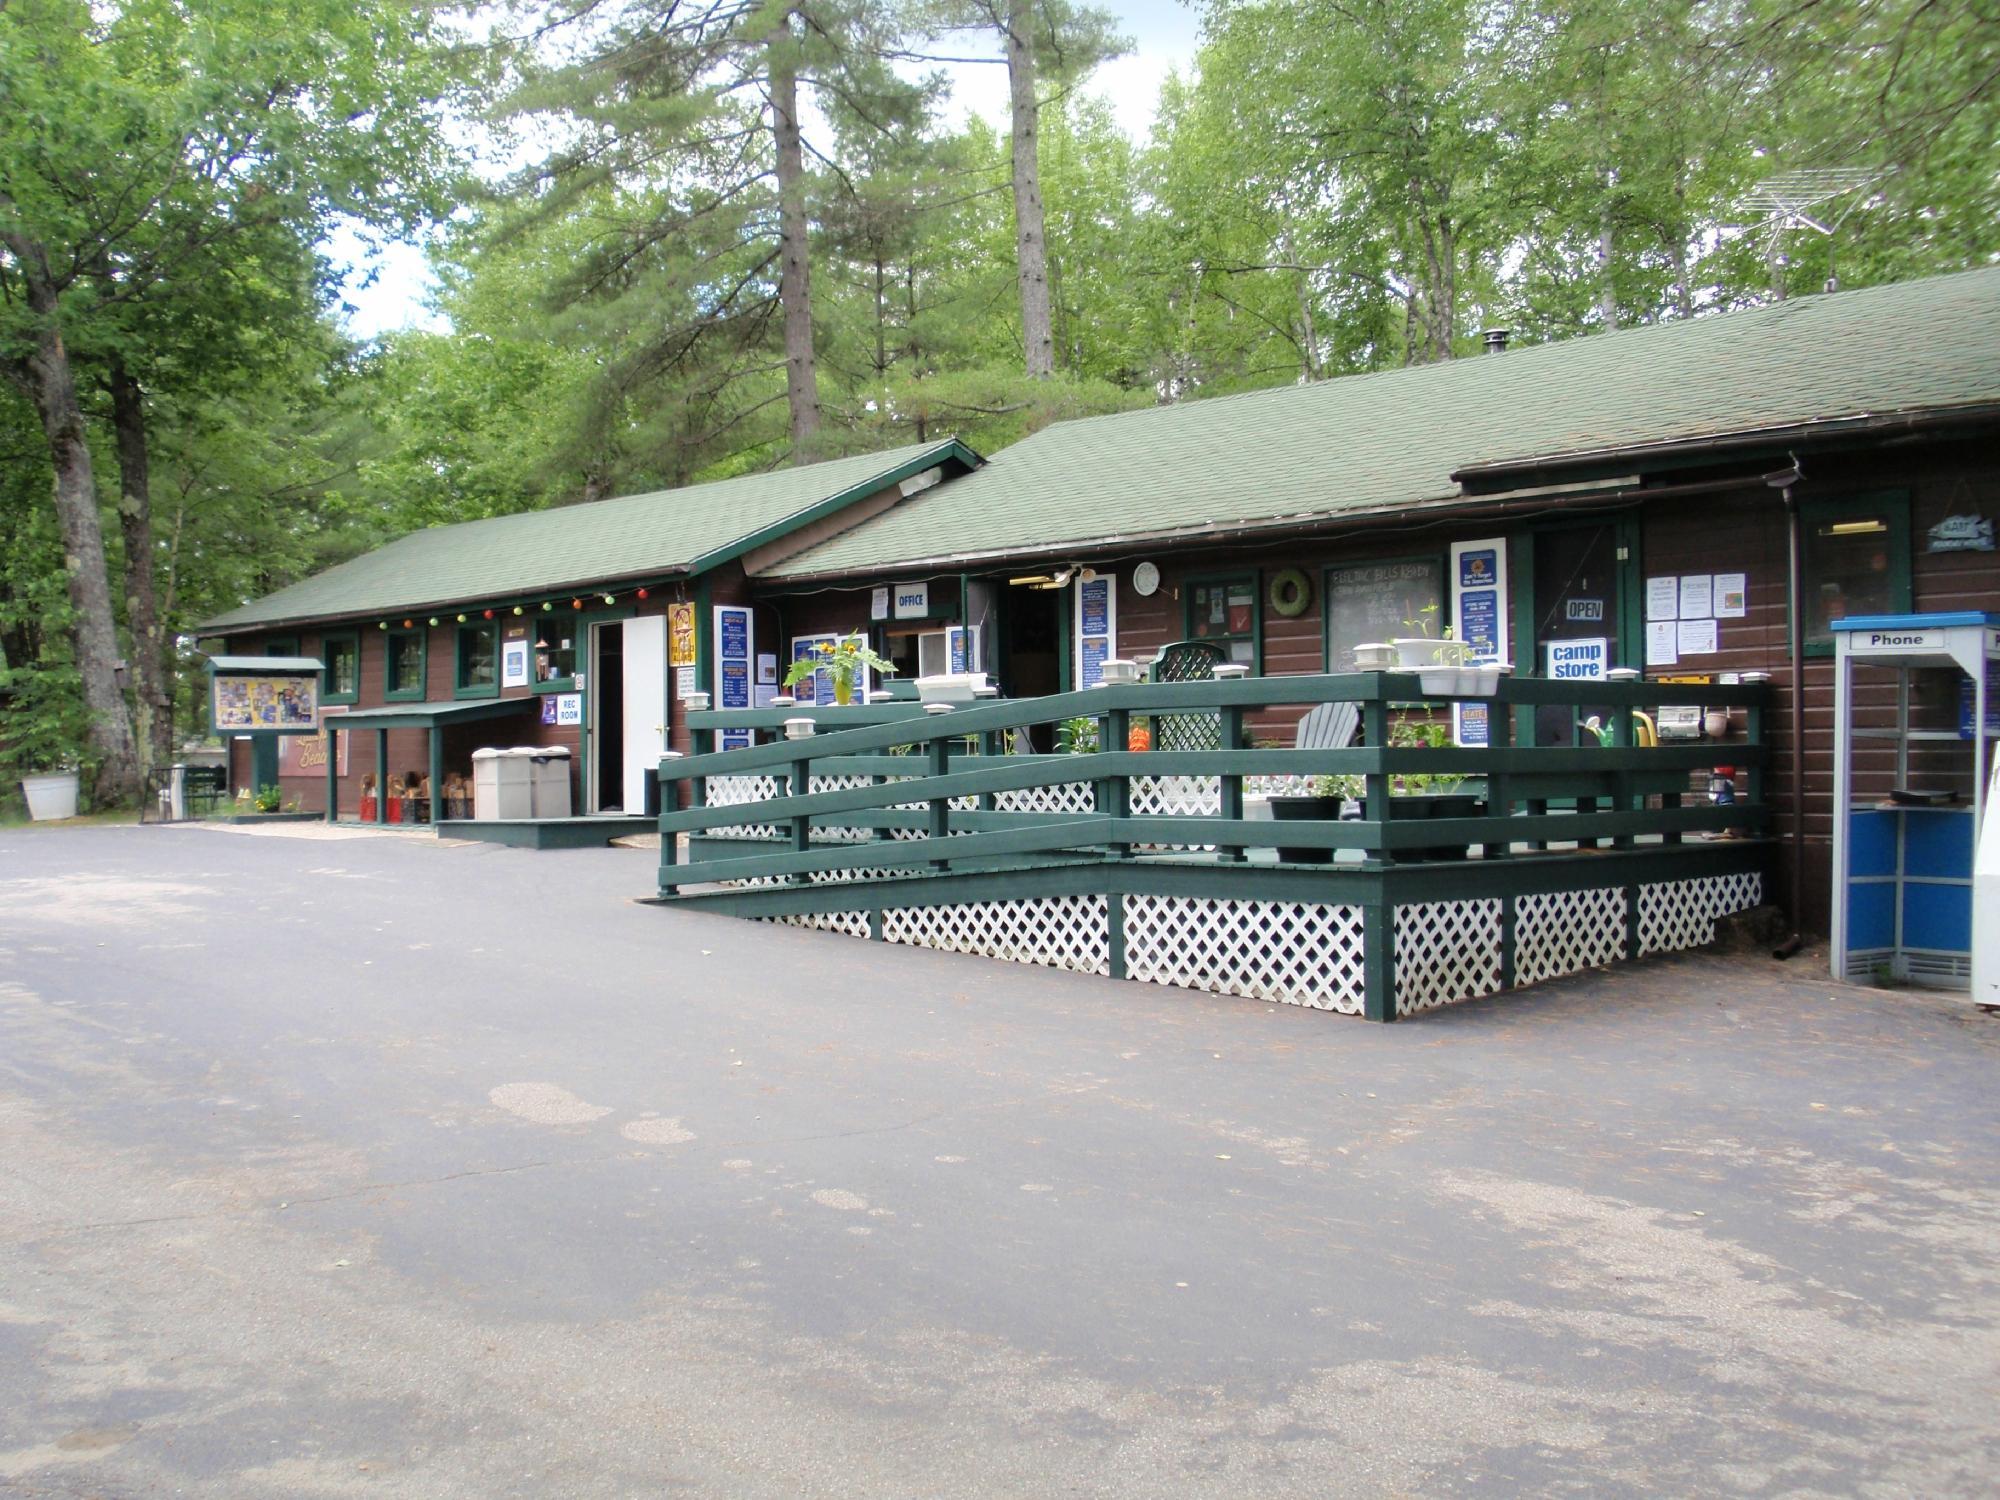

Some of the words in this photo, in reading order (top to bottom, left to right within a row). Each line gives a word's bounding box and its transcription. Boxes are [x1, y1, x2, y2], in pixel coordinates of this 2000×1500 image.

[899, 594, 924, 607] OFFICE
[1569, 602, 1602, 618] OPEN
[1872, 634, 1924, 646] Phone
[1553, 645, 1601, 661] camp
[1555, 662, 1600, 678] store
[563, 699, 576, 709] REC
[560, 710, 578, 720] ROOM
